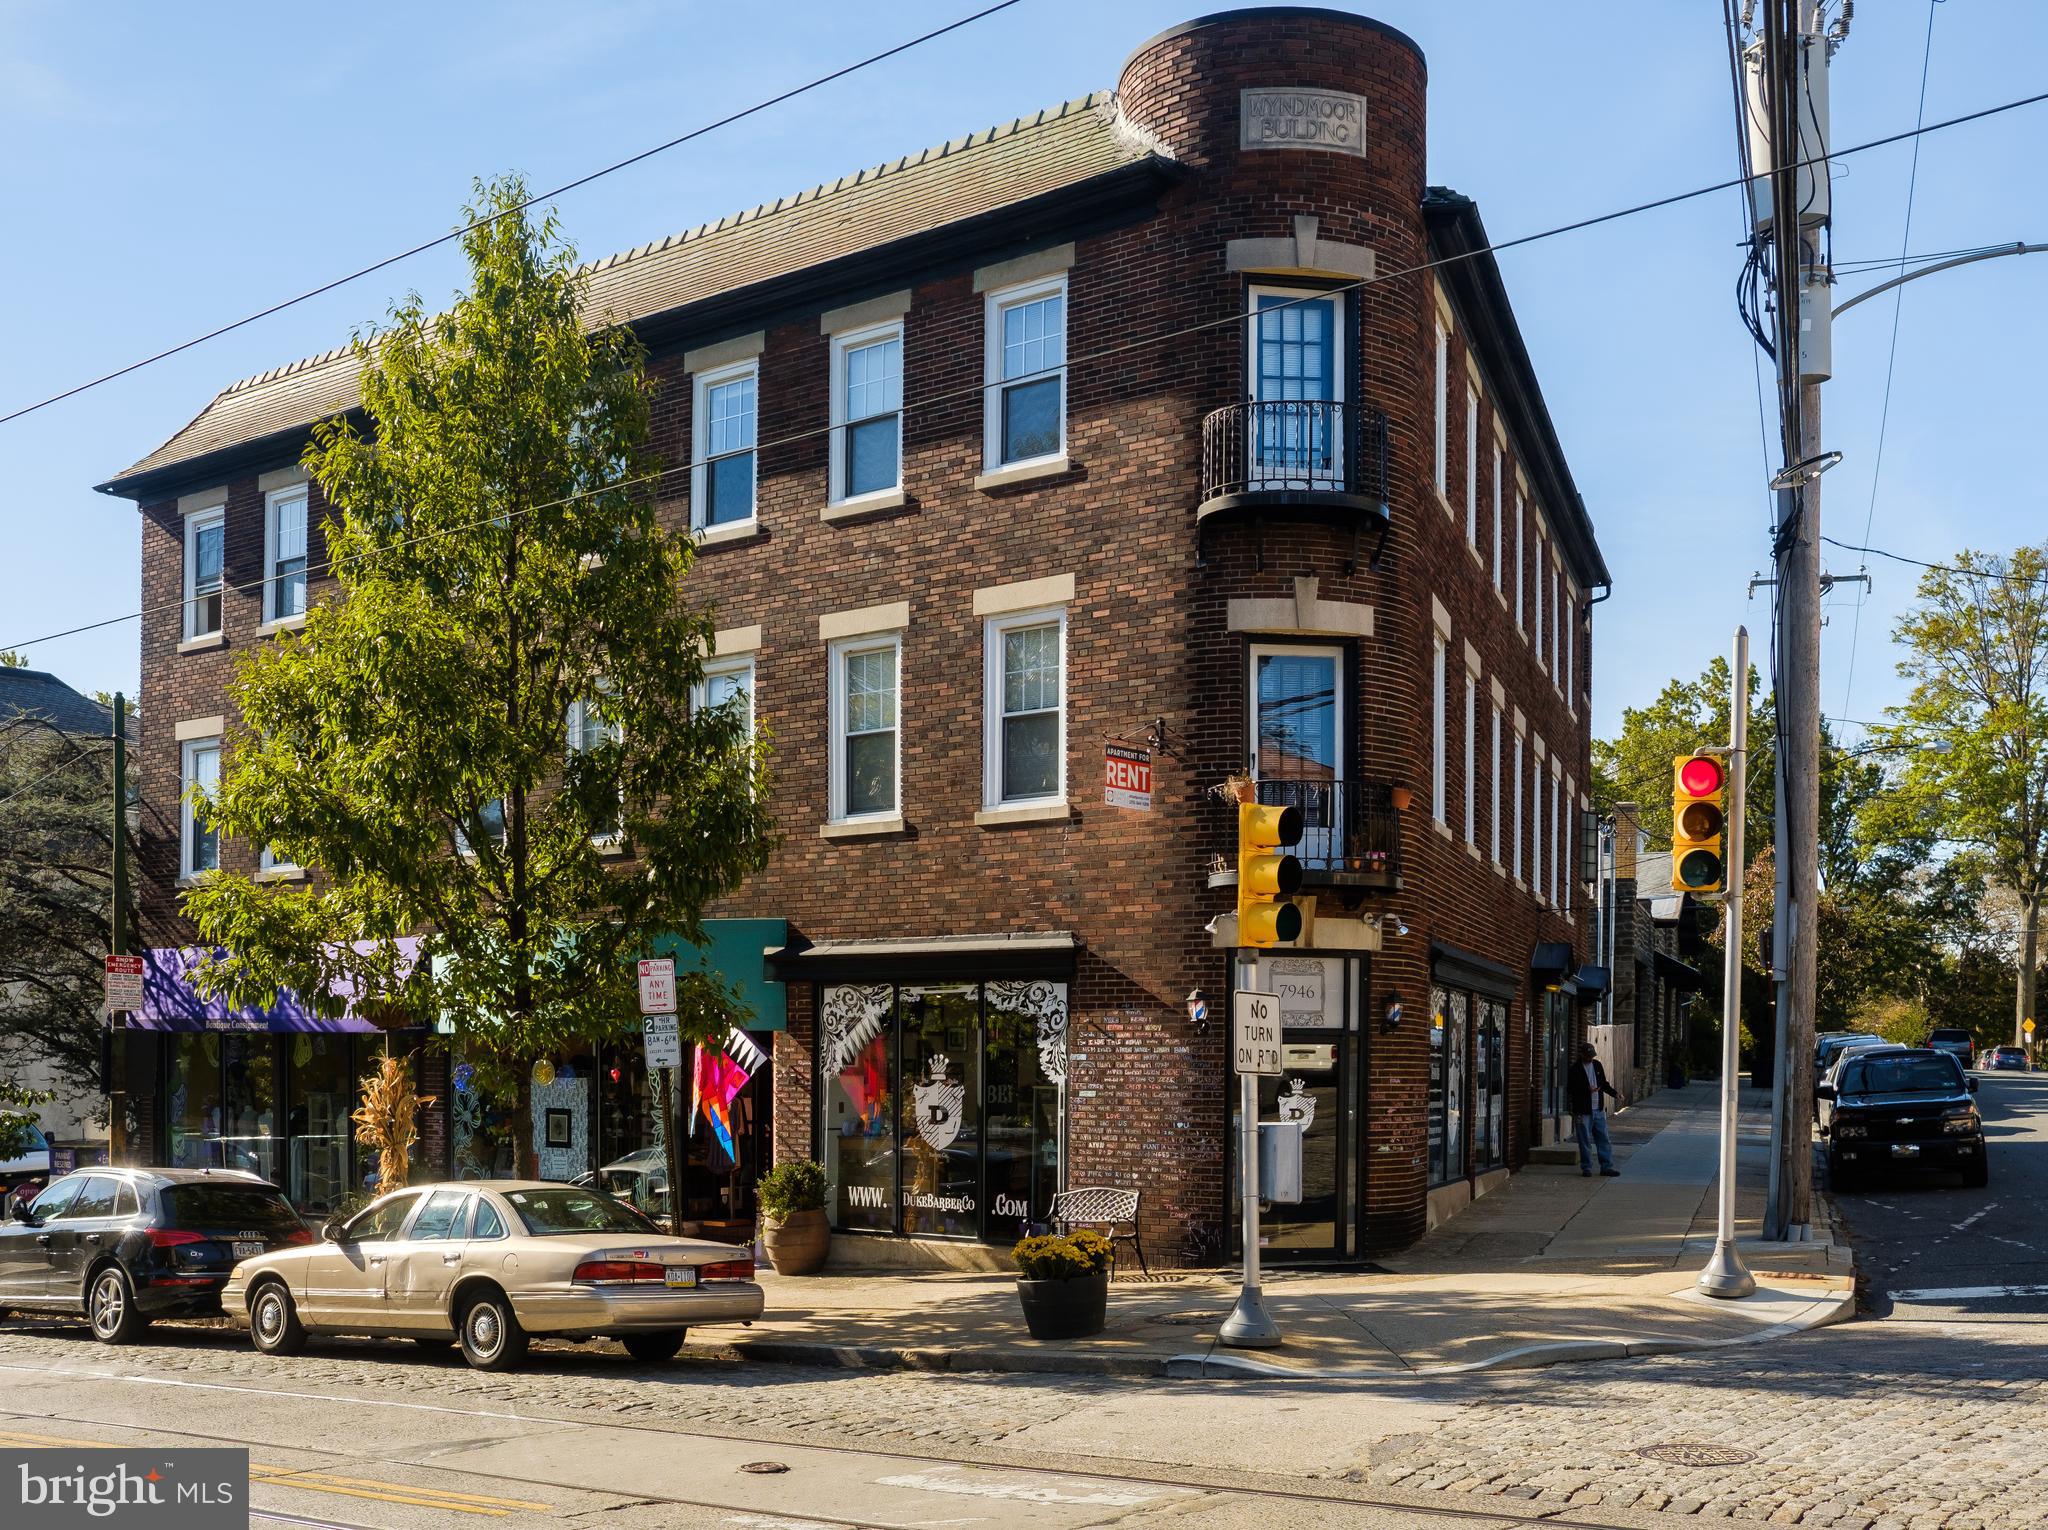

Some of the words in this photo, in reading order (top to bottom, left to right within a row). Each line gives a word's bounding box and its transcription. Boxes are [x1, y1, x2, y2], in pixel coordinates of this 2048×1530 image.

[1249, 96, 1357, 122] WYNDMOOR
[1261, 119, 1349, 142] BUILDING
[1107, 748, 1137, 760] APARTMENT
[1139, 754, 1150, 762] FOR
[1106, 760, 1149, 790] RENT
[640, 964, 649, 976] NO
[650, 964, 672, 974] PARKING
[649, 980, 665, 989] ANY
[1280, 984, 1315, 999] 7946
[648, 991, 668, 1000] TIME
[1251, 1004, 1268, 1020] NO
[206, 1020, 230, 1031] Boutique
[231, 1020, 268, 1031] Consignment
[645, 1019, 654, 1032] 2
[1245, 1026, 1273, 1042] TURN
[1238, 1048, 1252, 1064] ON
[928, 1105, 949, 1126] D
[1289, 1109, 1305, 1120] D
[848, 1186, 887, 1208] WWW.
